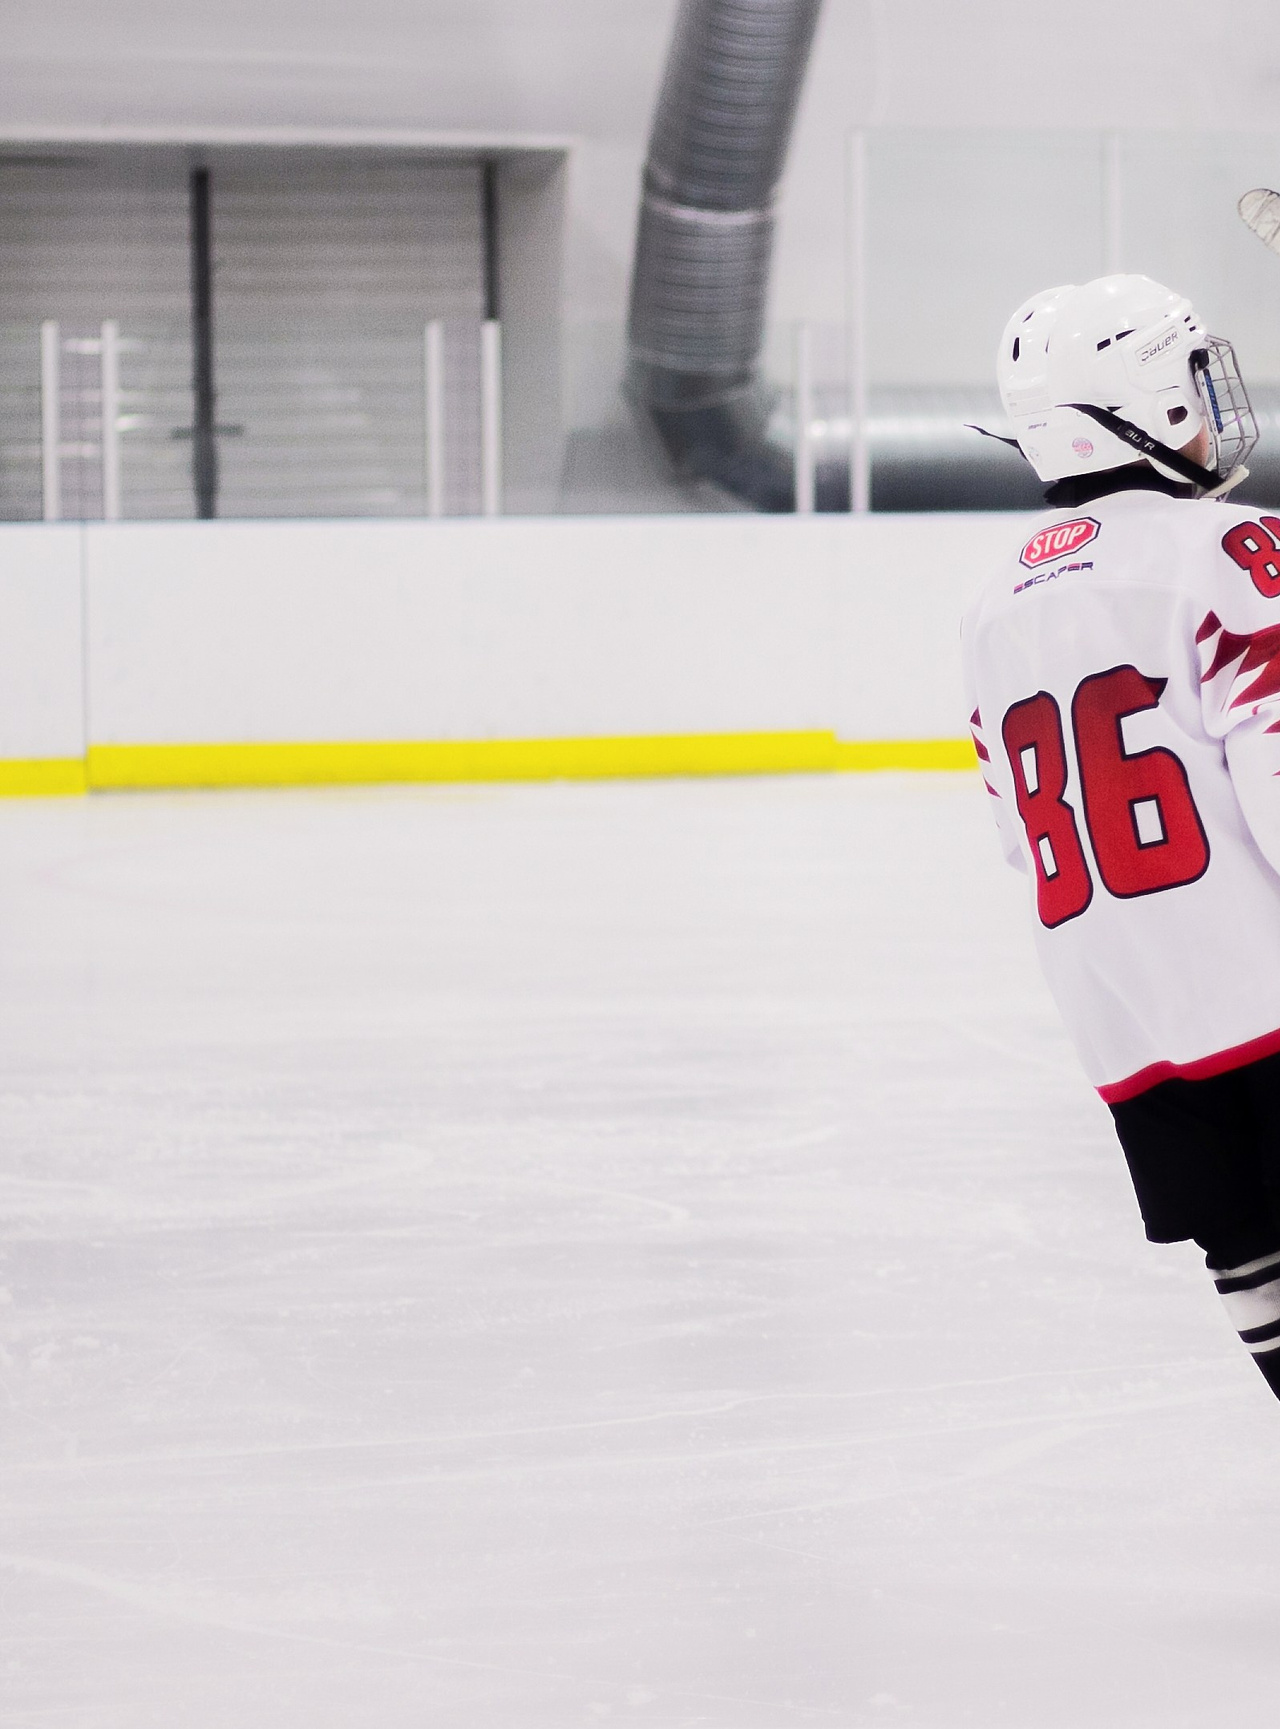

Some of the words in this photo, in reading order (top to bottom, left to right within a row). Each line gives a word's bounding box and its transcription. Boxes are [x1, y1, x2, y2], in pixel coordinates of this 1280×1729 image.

[1030, 524, 1088, 560] STOP
[1013, 561, 1093, 595] ESCAPER
[1001, 663, 1212, 930] 86
